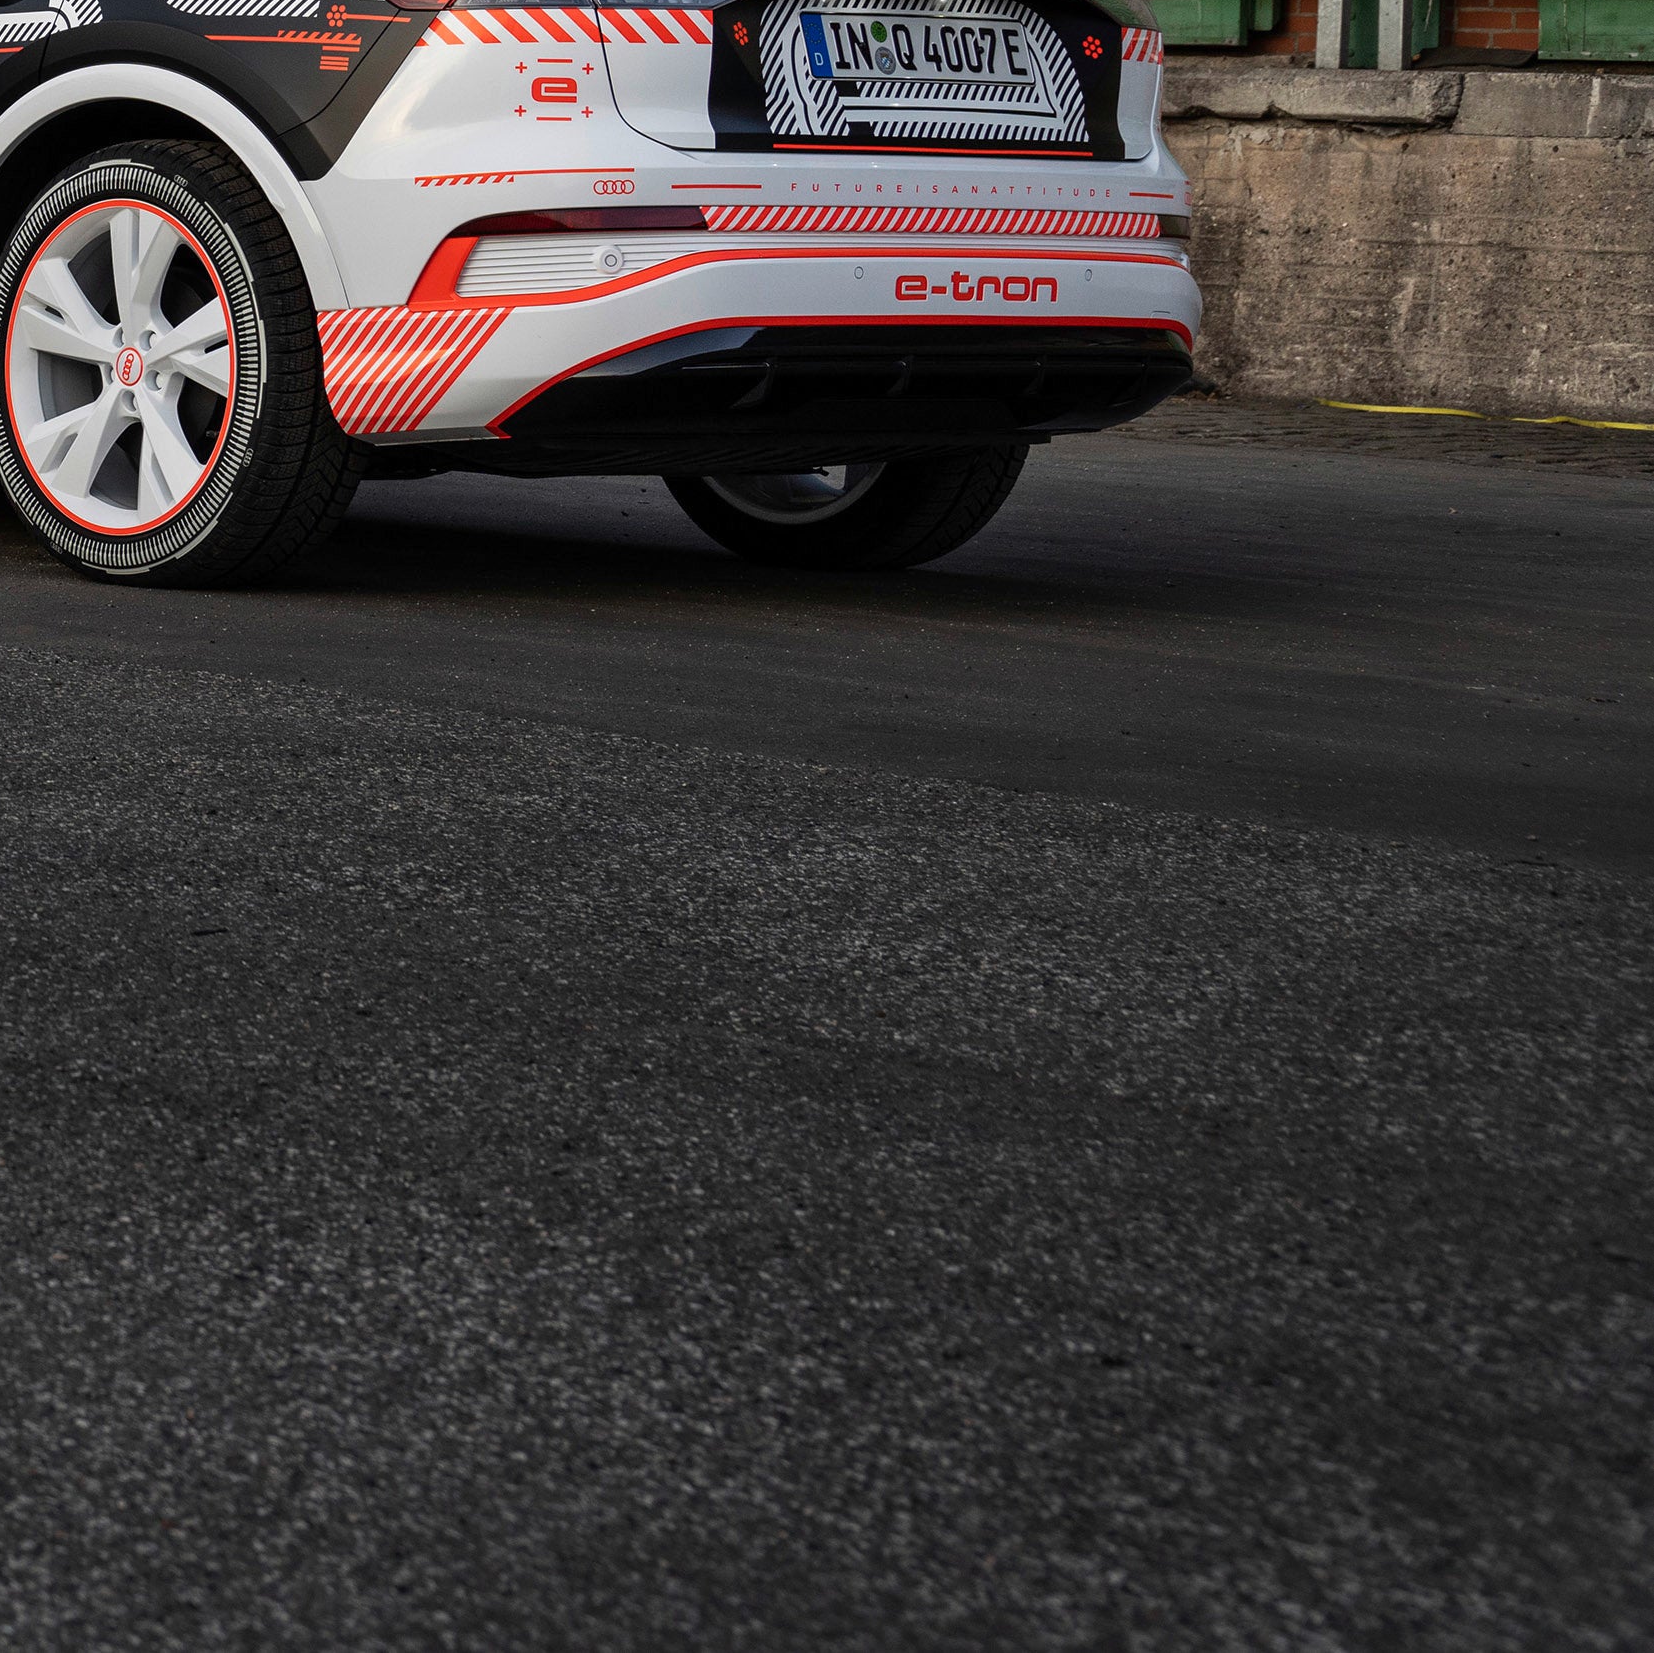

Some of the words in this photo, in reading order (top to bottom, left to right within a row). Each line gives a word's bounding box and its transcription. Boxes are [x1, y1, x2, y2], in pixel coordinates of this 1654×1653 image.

[814, 52, 824, 66] D
[829, 22, 874, 70] IN
[891, 24, 918, 71] Q
[895, 271, 1058, 302] e-tron
